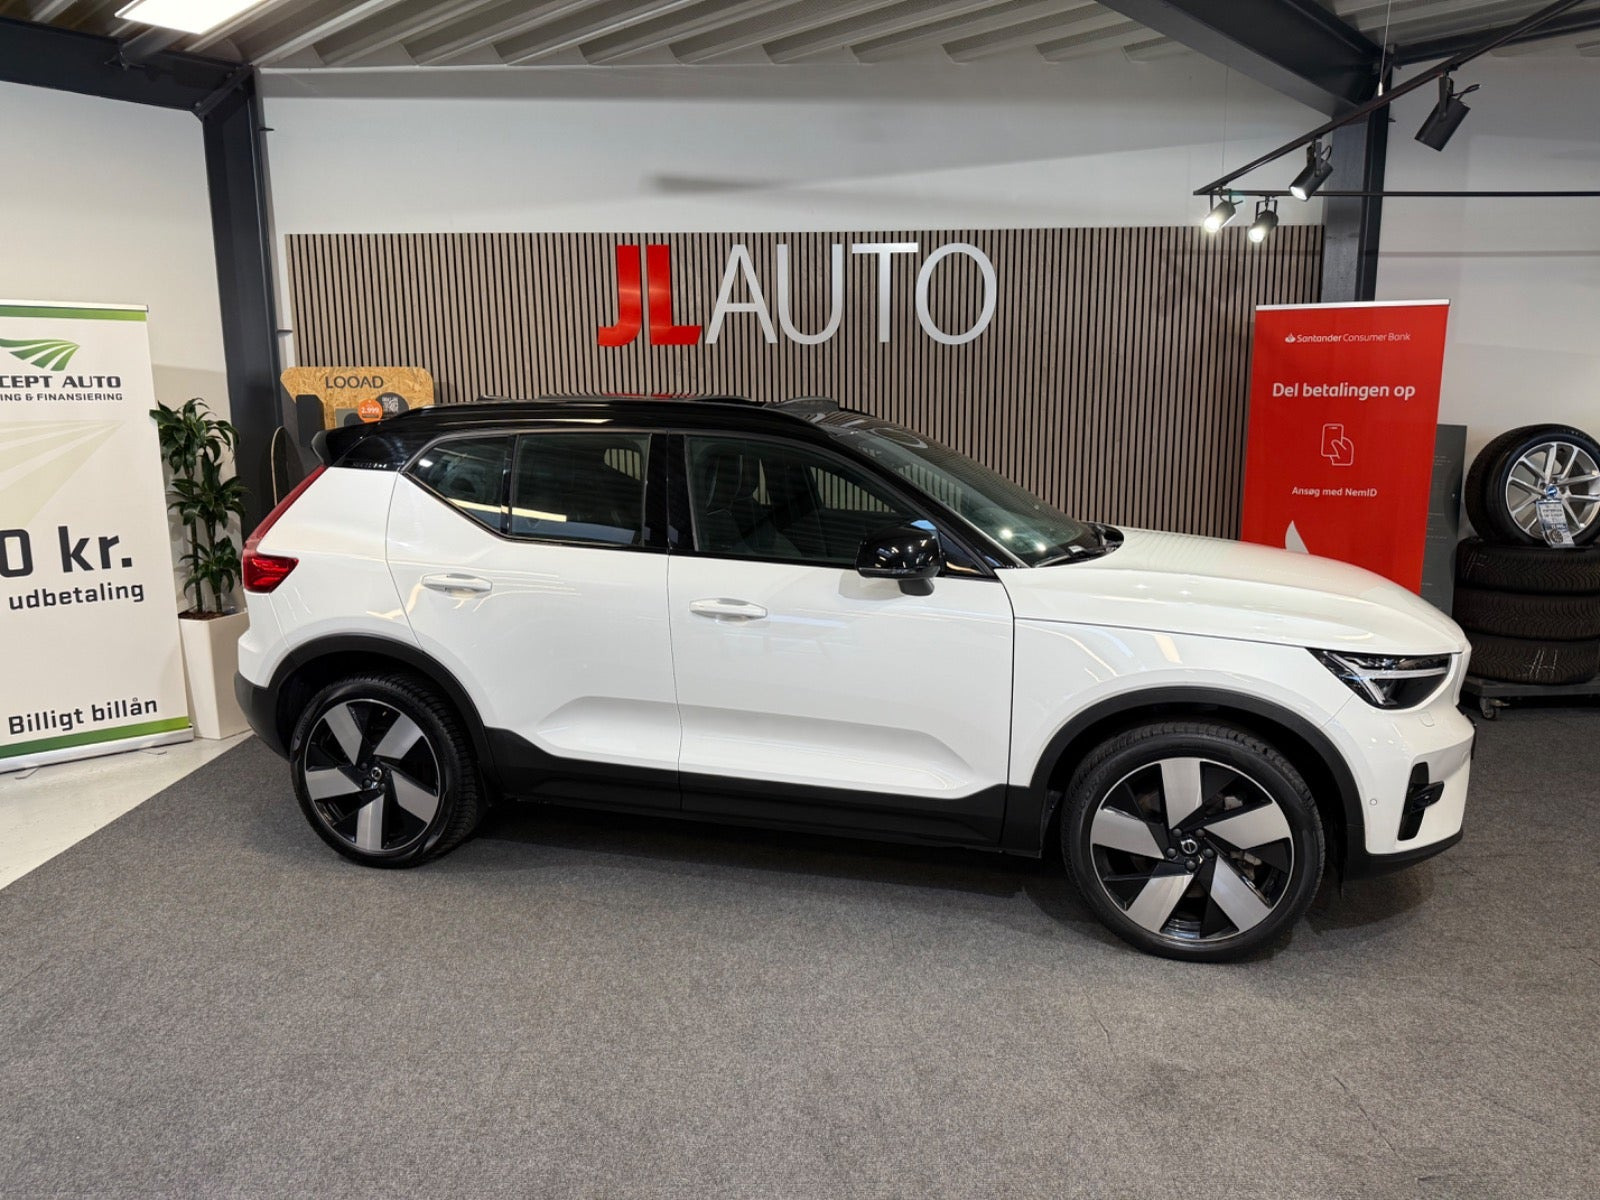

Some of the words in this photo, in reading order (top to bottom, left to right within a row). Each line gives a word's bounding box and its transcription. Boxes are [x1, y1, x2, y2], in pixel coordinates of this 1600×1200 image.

[1296, 334, 1341, 343] Santander
[1343, 333, 1387, 342] Consumer
[1388, 332, 1411, 341] Bank
[0, 375, 53, 389] CEPT
[62, 375, 122, 389] AUTO
[325, 375, 384, 389] LOOAD
[25, 393, 34, 401] &
[37, 393, 123, 401] FINANSIERING
[1272, 382, 1299, 397] Del
[1302, 382, 1390, 401] betalingen
[1393, 385, 1416, 401] op
[1292, 486, 1321, 498] Ansøg
[1322, 488, 1343, 496] med
[1345, 488, 1378, 497] NemID
[57, 525, 133, 573] kr.
[8, 582, 145, 610] udbetaling
[8, 708, 84, 735] Billigt
[91, 697, 158, 722] billån
